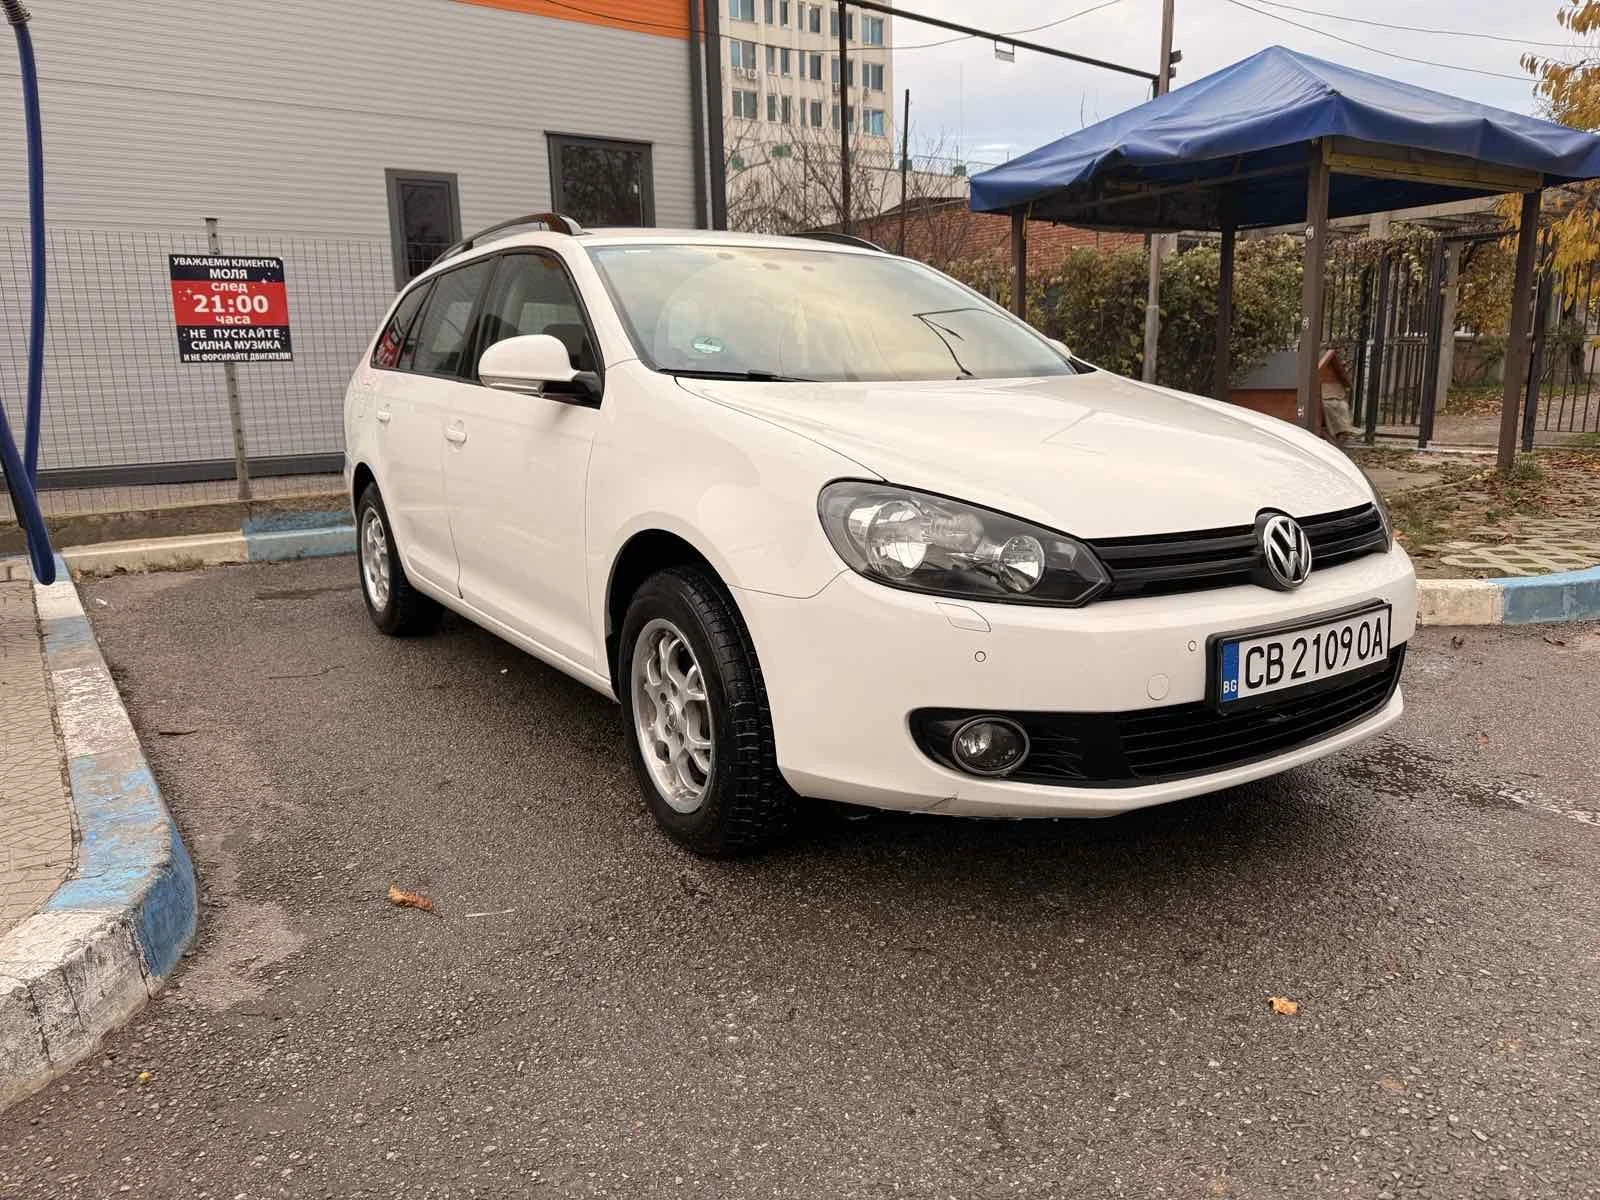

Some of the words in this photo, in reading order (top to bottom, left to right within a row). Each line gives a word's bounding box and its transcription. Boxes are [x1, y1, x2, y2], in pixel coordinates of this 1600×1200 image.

[173, 257, 229, 267] УВАЖАЕМИ
[232, 259, 280, 269] КЛИЕНТИ,
[209, 269, 248, 280] МОЛЯ
[211, 282, 248, 293] след
[193, 295, 269, 313] 21:00
[215, 315, 251, 325] часа
[189, 329, 207, 338] НЕ
[213, 328, 281, 338] ПУСКАЙТЕ
[191, 341, 232, 350] СИЛНА
[234, 340, 281, 350] МУЗИКА
[190, 353, 200, 361] НЕ
[201, 352, 249, 361] ФОРСИРАЙТЕ
[1223, 680, 1238, 694] BG
